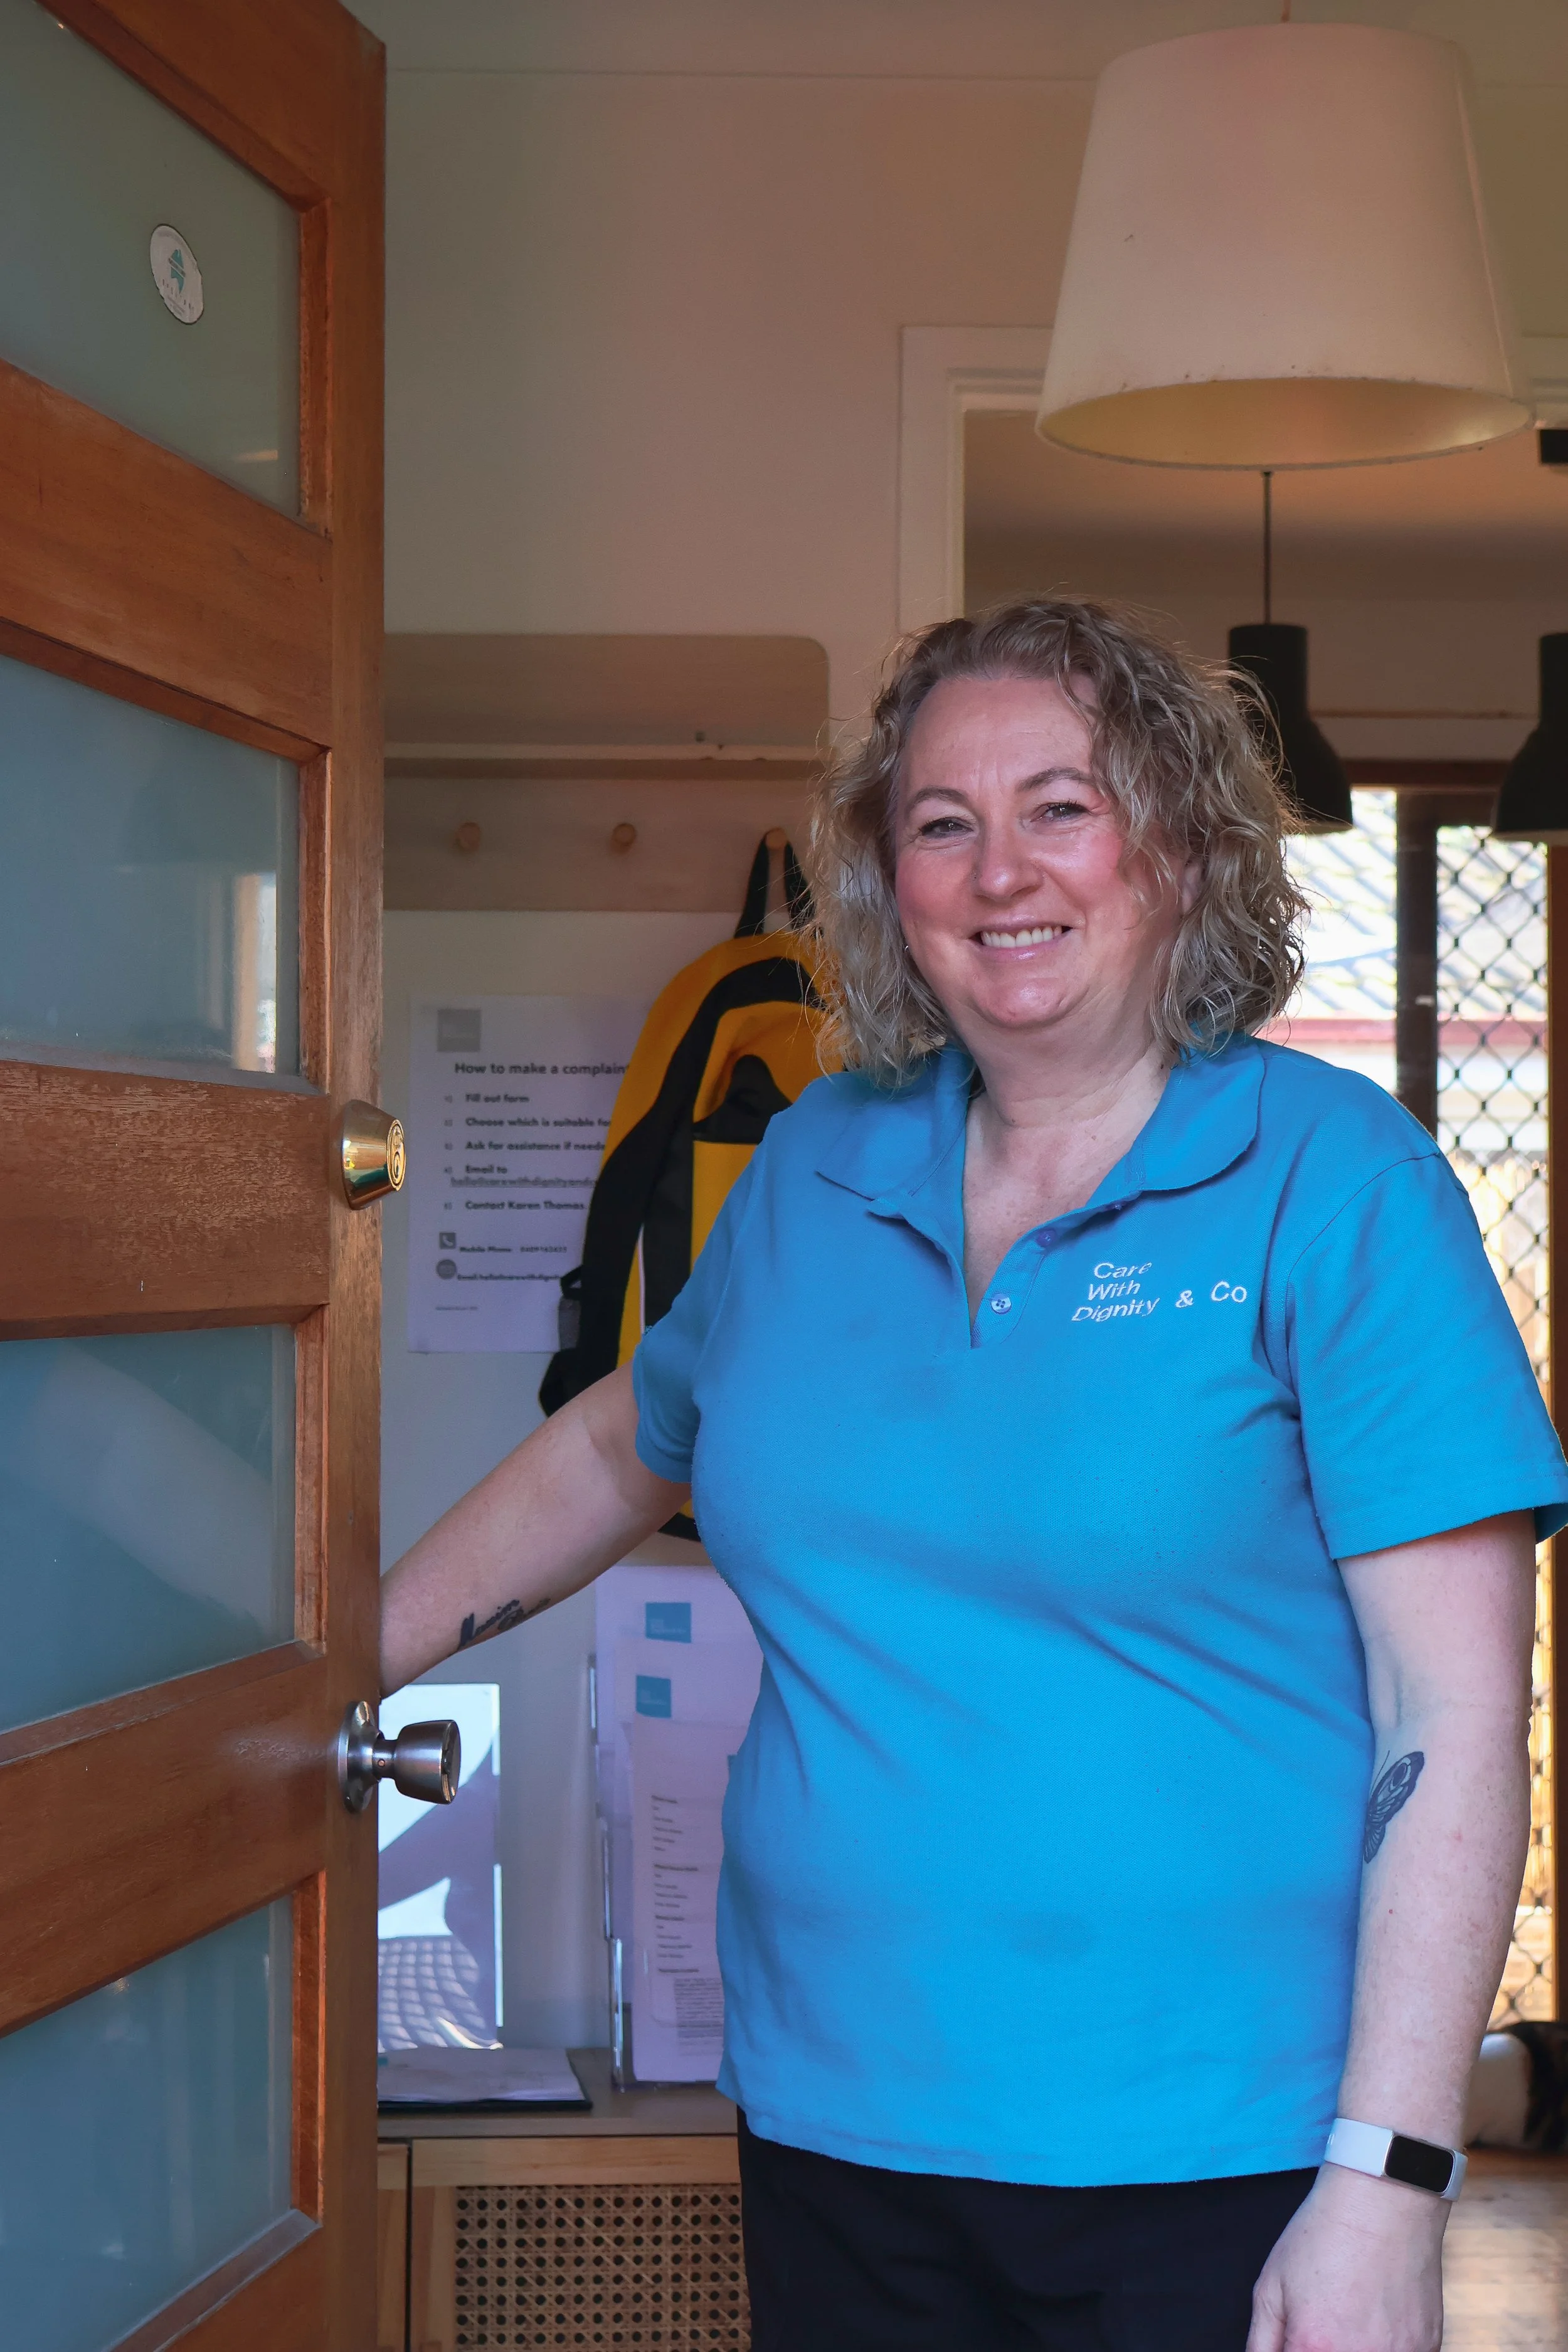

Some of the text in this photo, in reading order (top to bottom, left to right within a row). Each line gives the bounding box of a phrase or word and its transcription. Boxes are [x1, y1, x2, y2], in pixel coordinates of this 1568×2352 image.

[455, 1063, 485, 1074] How
[490, 1063, 505, 1074] to
[509, 1062, 547, 1074] make
[551, 1065, 558, 1074] a
[465, 1093, 529, 1102] Fill out form
[465, 1118, 504, 1126] Choose
[507, 1118, 538, 1126] which
[541, 1118, 549, 1126] is
[553, 1118, 594, 1126] suitable
[465, 1140, 485, 1150] Ask
[489, 1140, 503, 1150] for
[507, 1141, 560, 1150] assistance
[564, 1140, 571, 1150] if
[465, 1165, 507, 1173] Email to
[465, 1200, 505, 1209] Contact
[508, 1200, 541, 1209] Karen
[1094, 1261, 1153, 1279] Care
[1087, 1280, 1142, 1301] With
[1071, 1280, 1248, 1323] Dignity & Co
